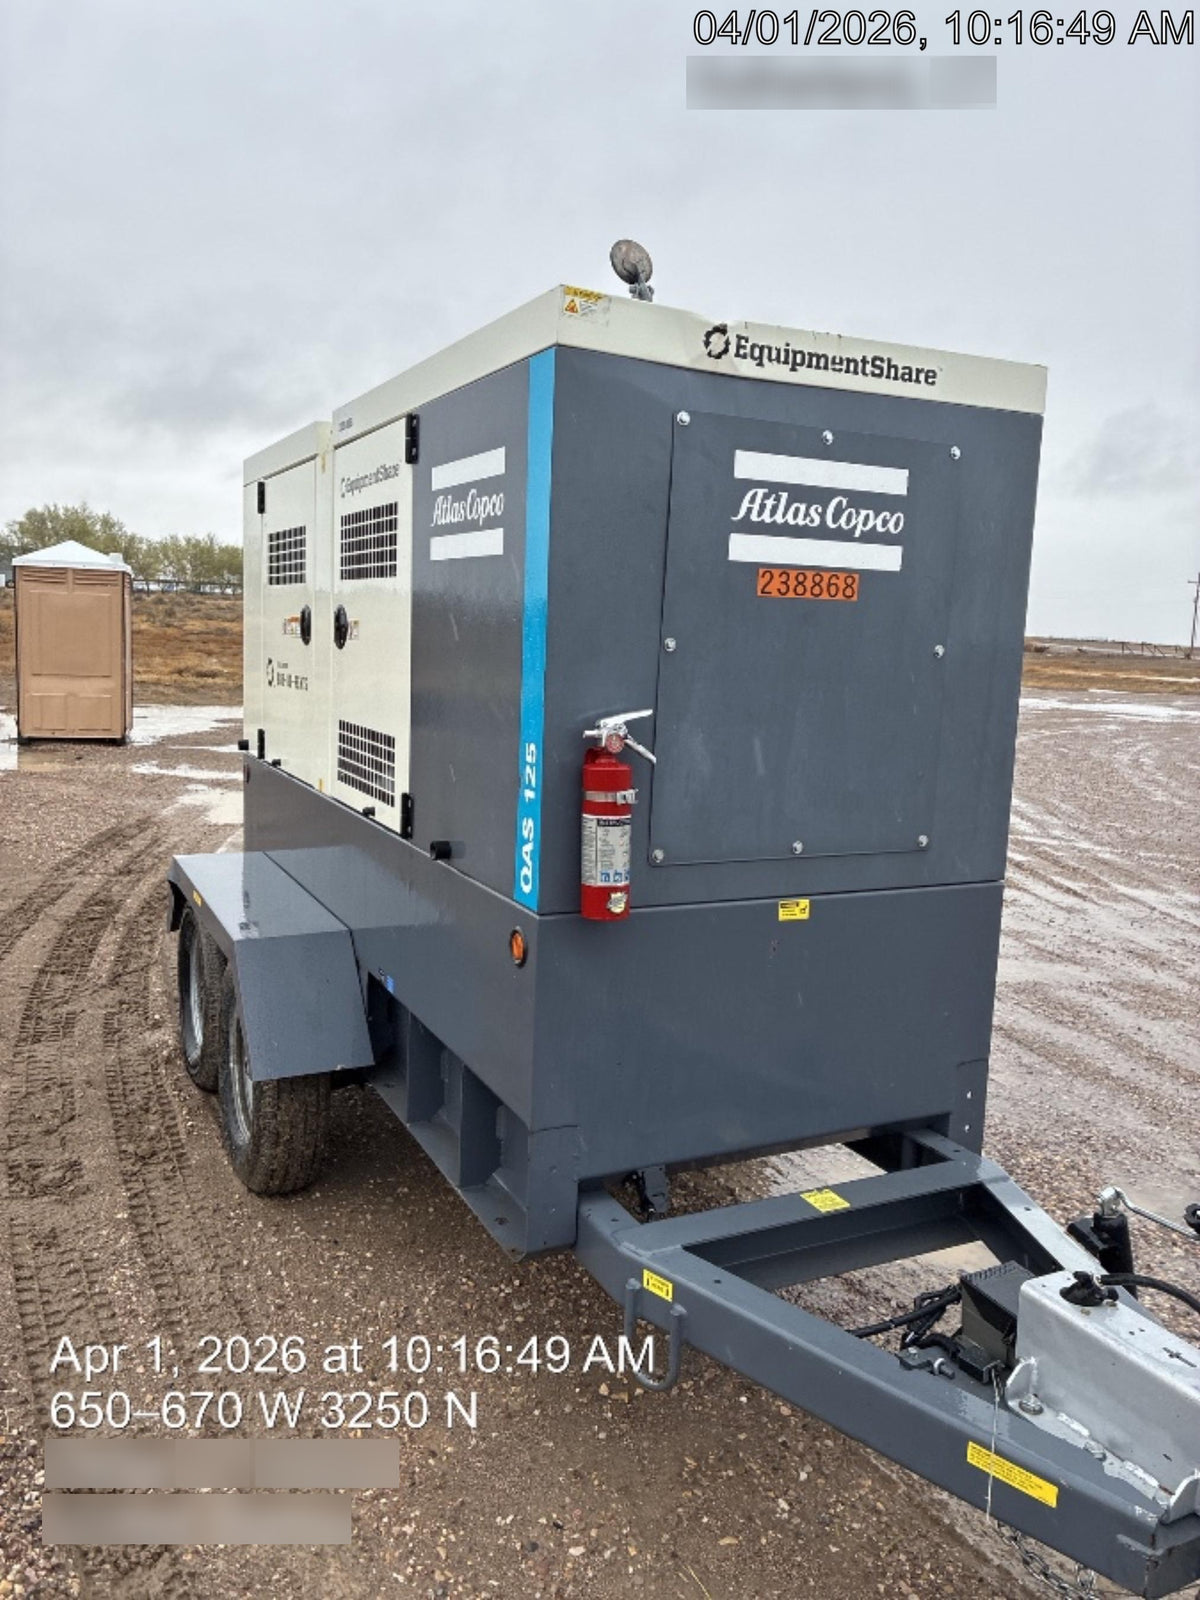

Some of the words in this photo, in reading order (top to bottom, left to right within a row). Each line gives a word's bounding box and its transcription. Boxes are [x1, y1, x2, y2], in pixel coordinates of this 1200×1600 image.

[734, 334, 938, 386] EquipmentShare
[731, 488, 823, 528] Atlas
[825, 496, 905, 537] Copco
[759, 570, 857, 600] 238868
[524, 742, 537, 803] 125
